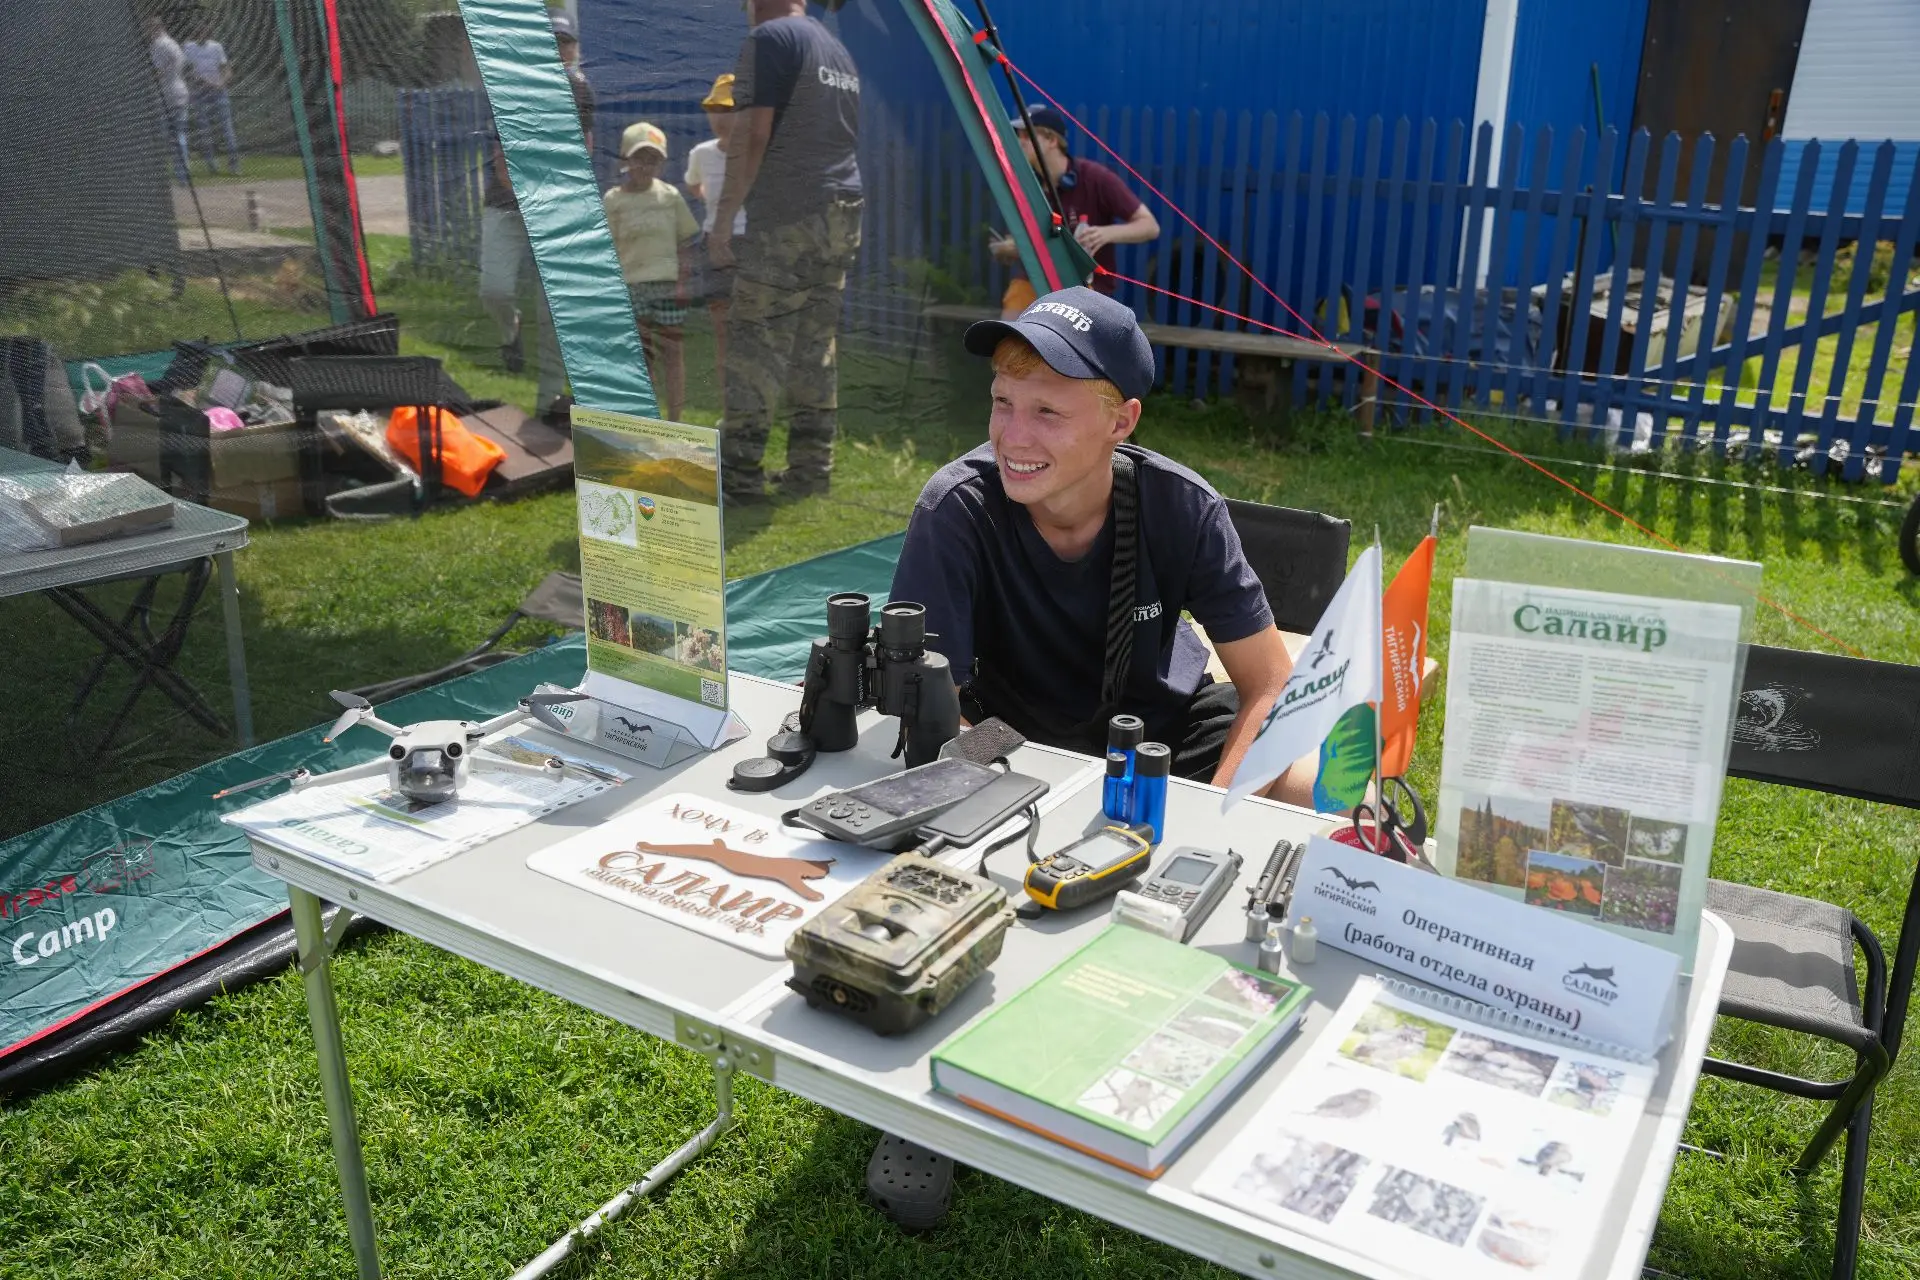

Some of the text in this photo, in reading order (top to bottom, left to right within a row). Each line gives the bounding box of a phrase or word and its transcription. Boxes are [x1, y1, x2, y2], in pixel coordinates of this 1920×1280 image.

[1513, 604, 1668, 653] Салаир
[598, 851, 804, 924] САЛАИР
[1313, 886, 1377, 917] ТИГИРЕКСКИЙ
[12, 907, 116, 966] Camp
[1402, 908, 1536, 972] Оперативная
[1343, 921, 1416, 963] (работа
[1419, 954, 1489, 992] отдела
[1493, 983, 1582, 1031] охраны)
[1561, 974, 1619, 1002] САЛАИР
